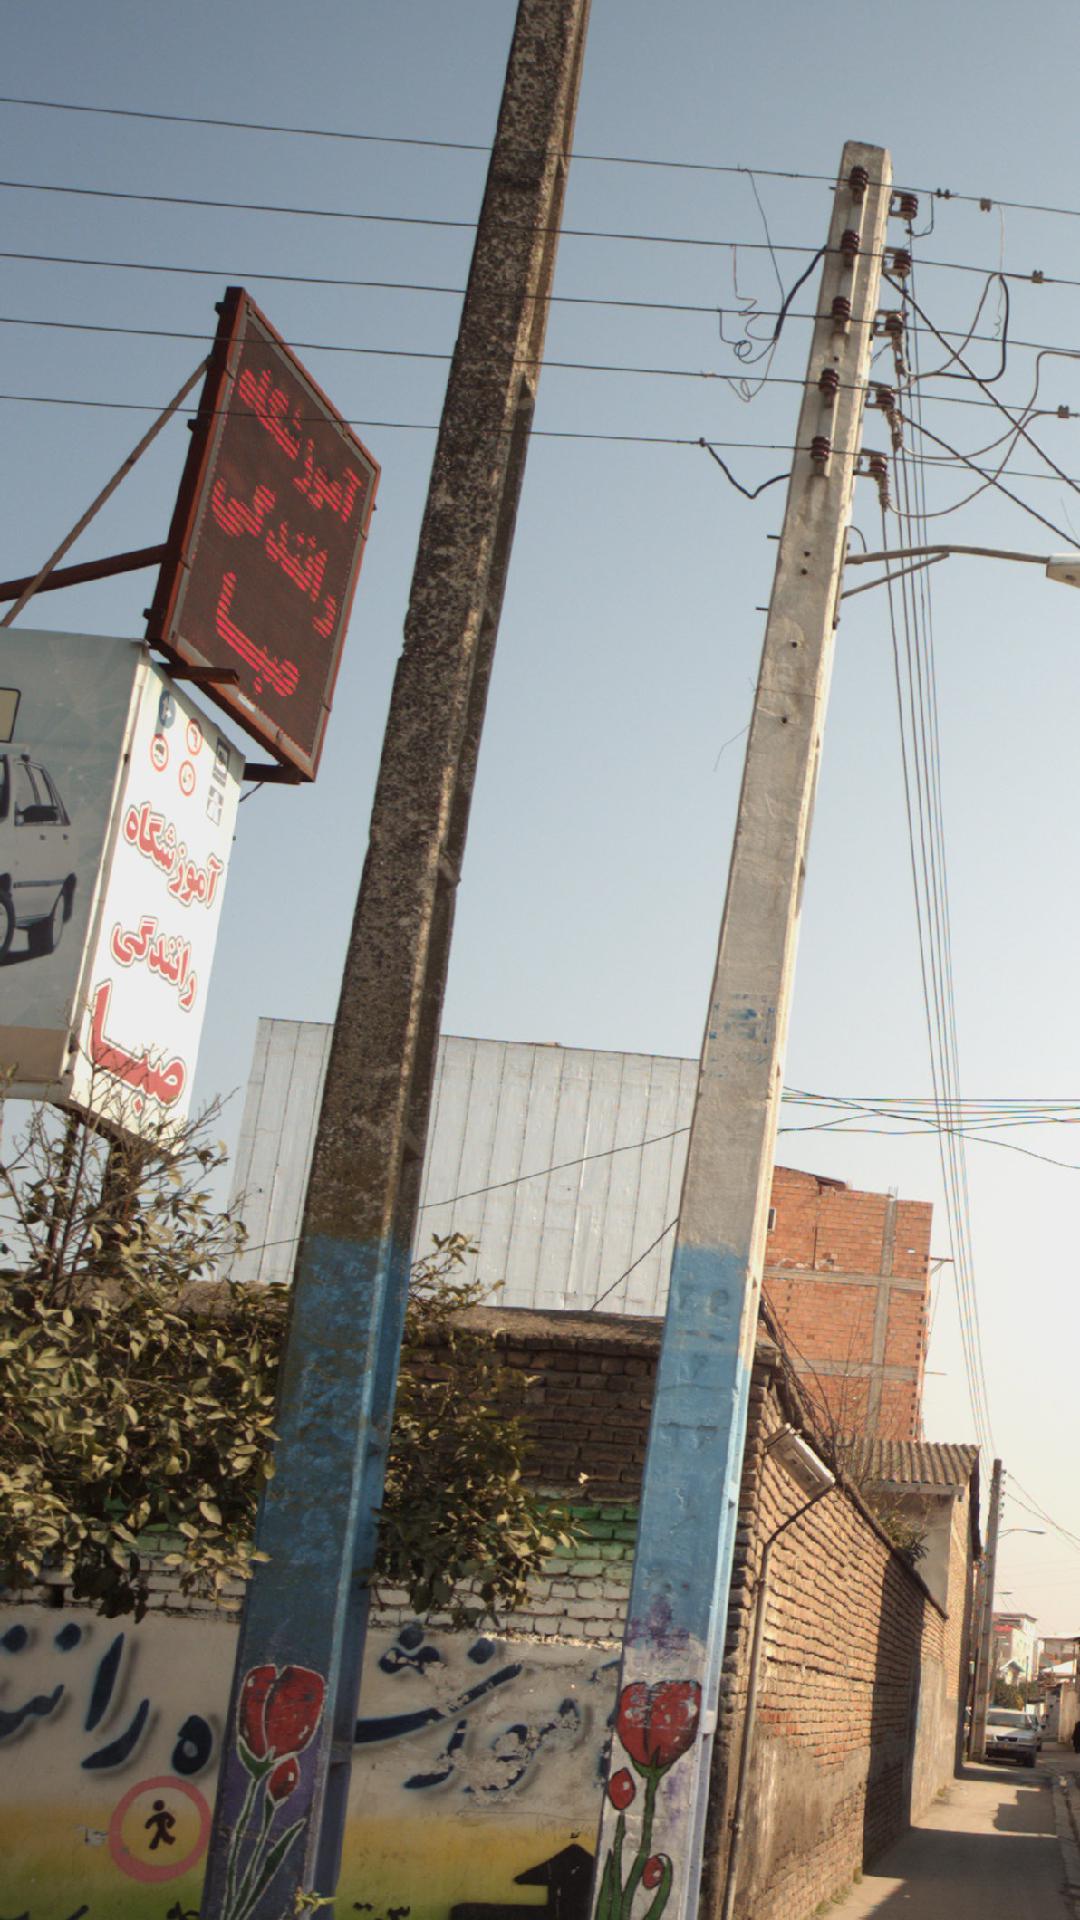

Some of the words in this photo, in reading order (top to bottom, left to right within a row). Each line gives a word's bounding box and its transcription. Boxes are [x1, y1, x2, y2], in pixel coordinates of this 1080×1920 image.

[238, 367, 363, 523] آموزشگاه
[211, 477, 337, 639] رانندگی
[215, 570, 300, 696] صبا
[124, 803, 222, 905] آموزشگاه
[112, 915, 197, 1008] رانندگی
[88, 982, 187, 1114] صبا
